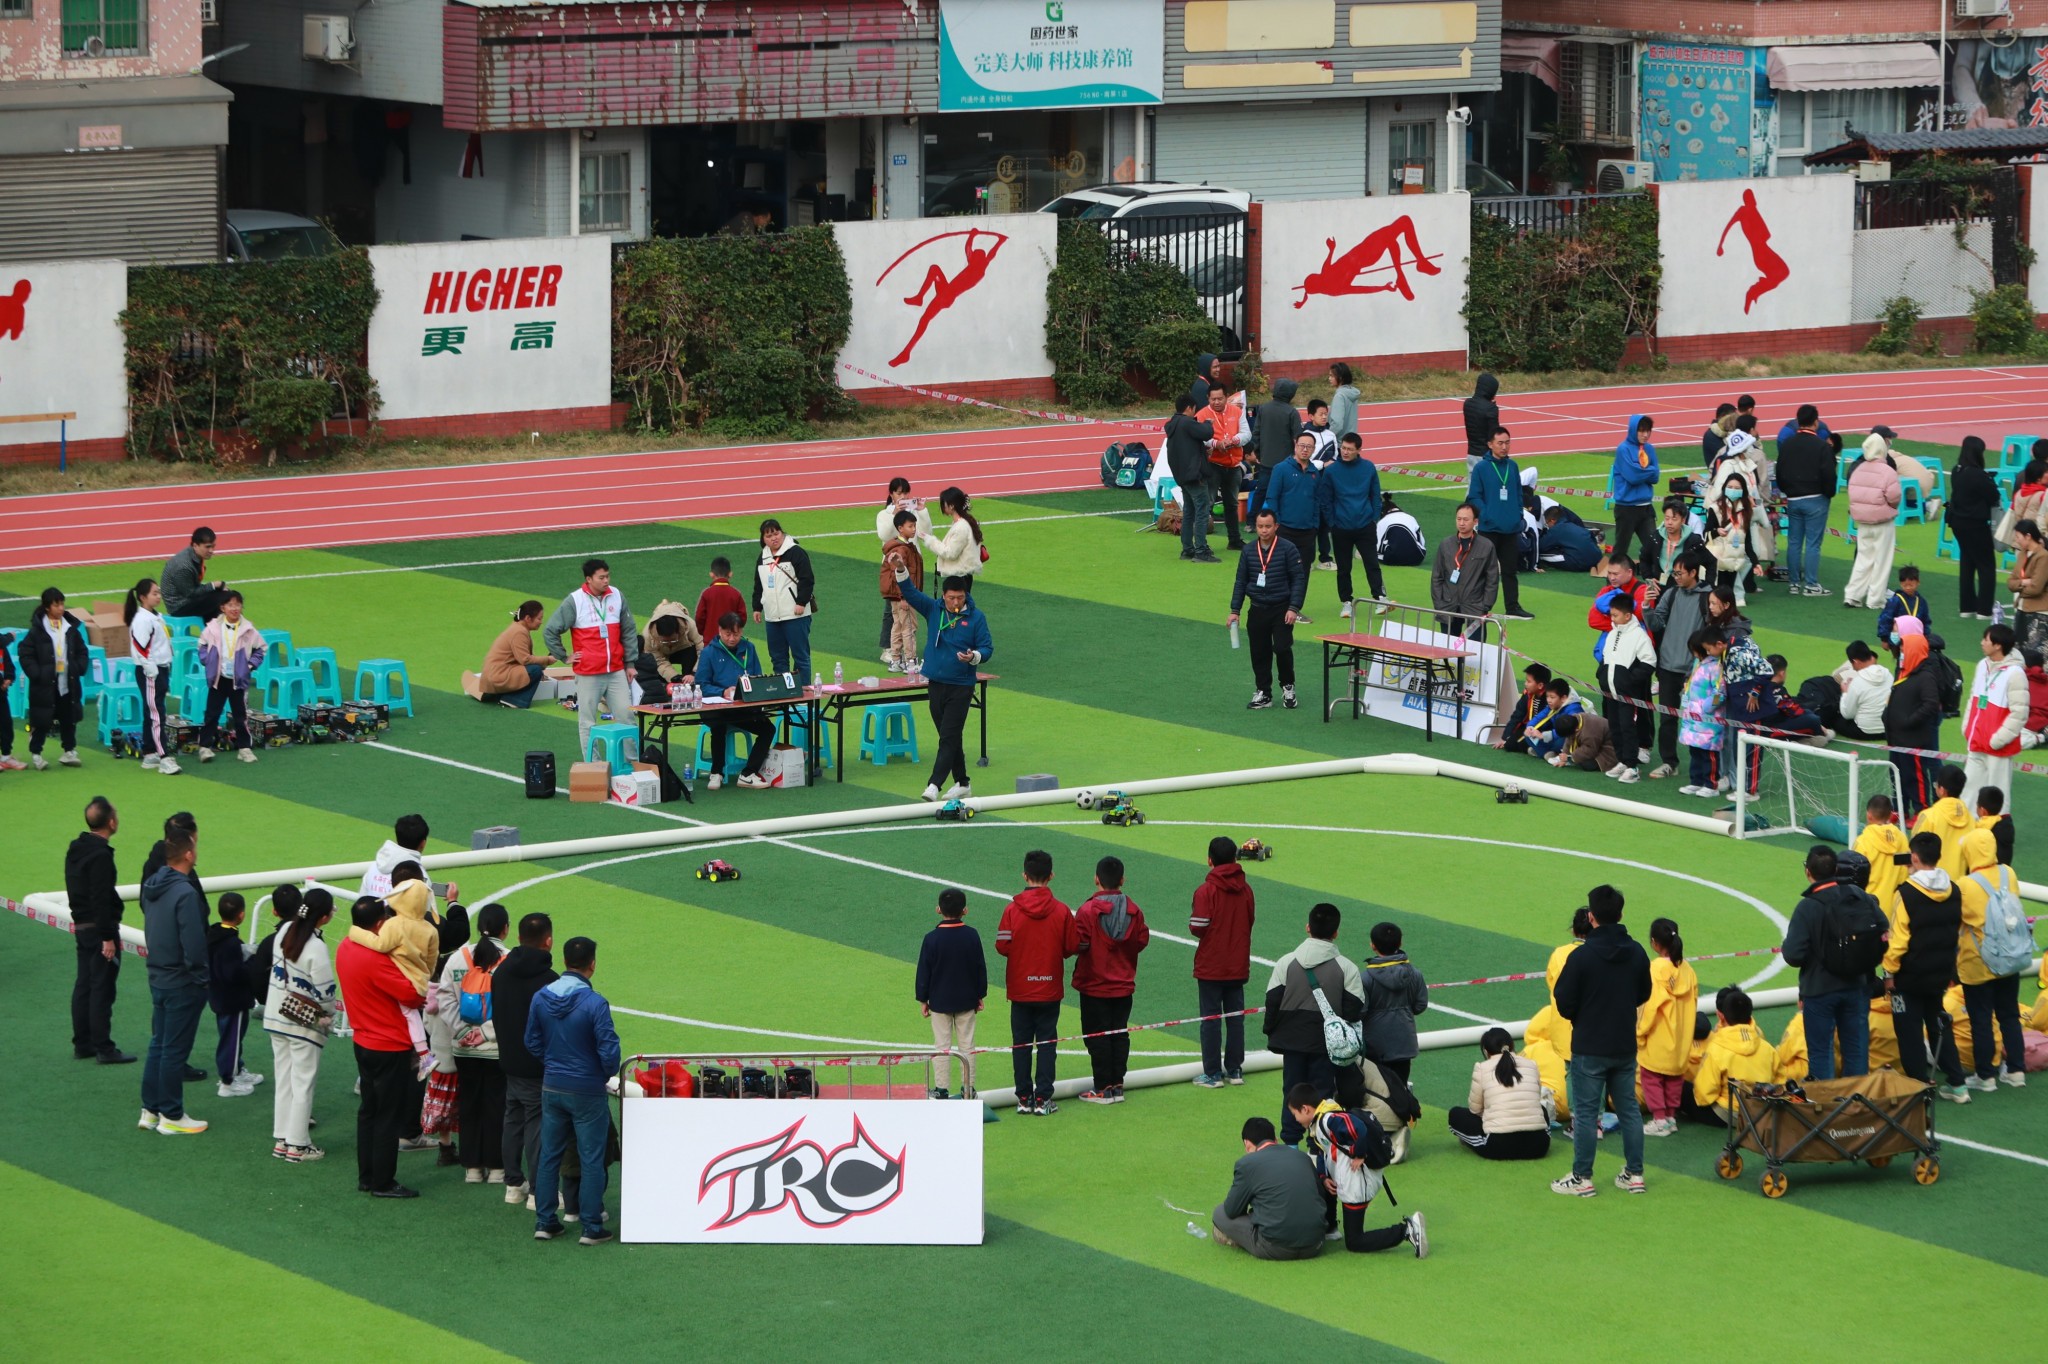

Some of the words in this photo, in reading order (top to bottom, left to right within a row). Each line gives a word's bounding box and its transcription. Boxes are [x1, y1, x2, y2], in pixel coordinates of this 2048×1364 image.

[1030, 25, 1079, 40] 国药世家
[974, 51, 1043, 74] 完美大师
[1048, 47, 1133, 71] 科技康养馆
[423, 265, 563, 314] HIGHER
[698, 1112, 906, 1231] TRC
